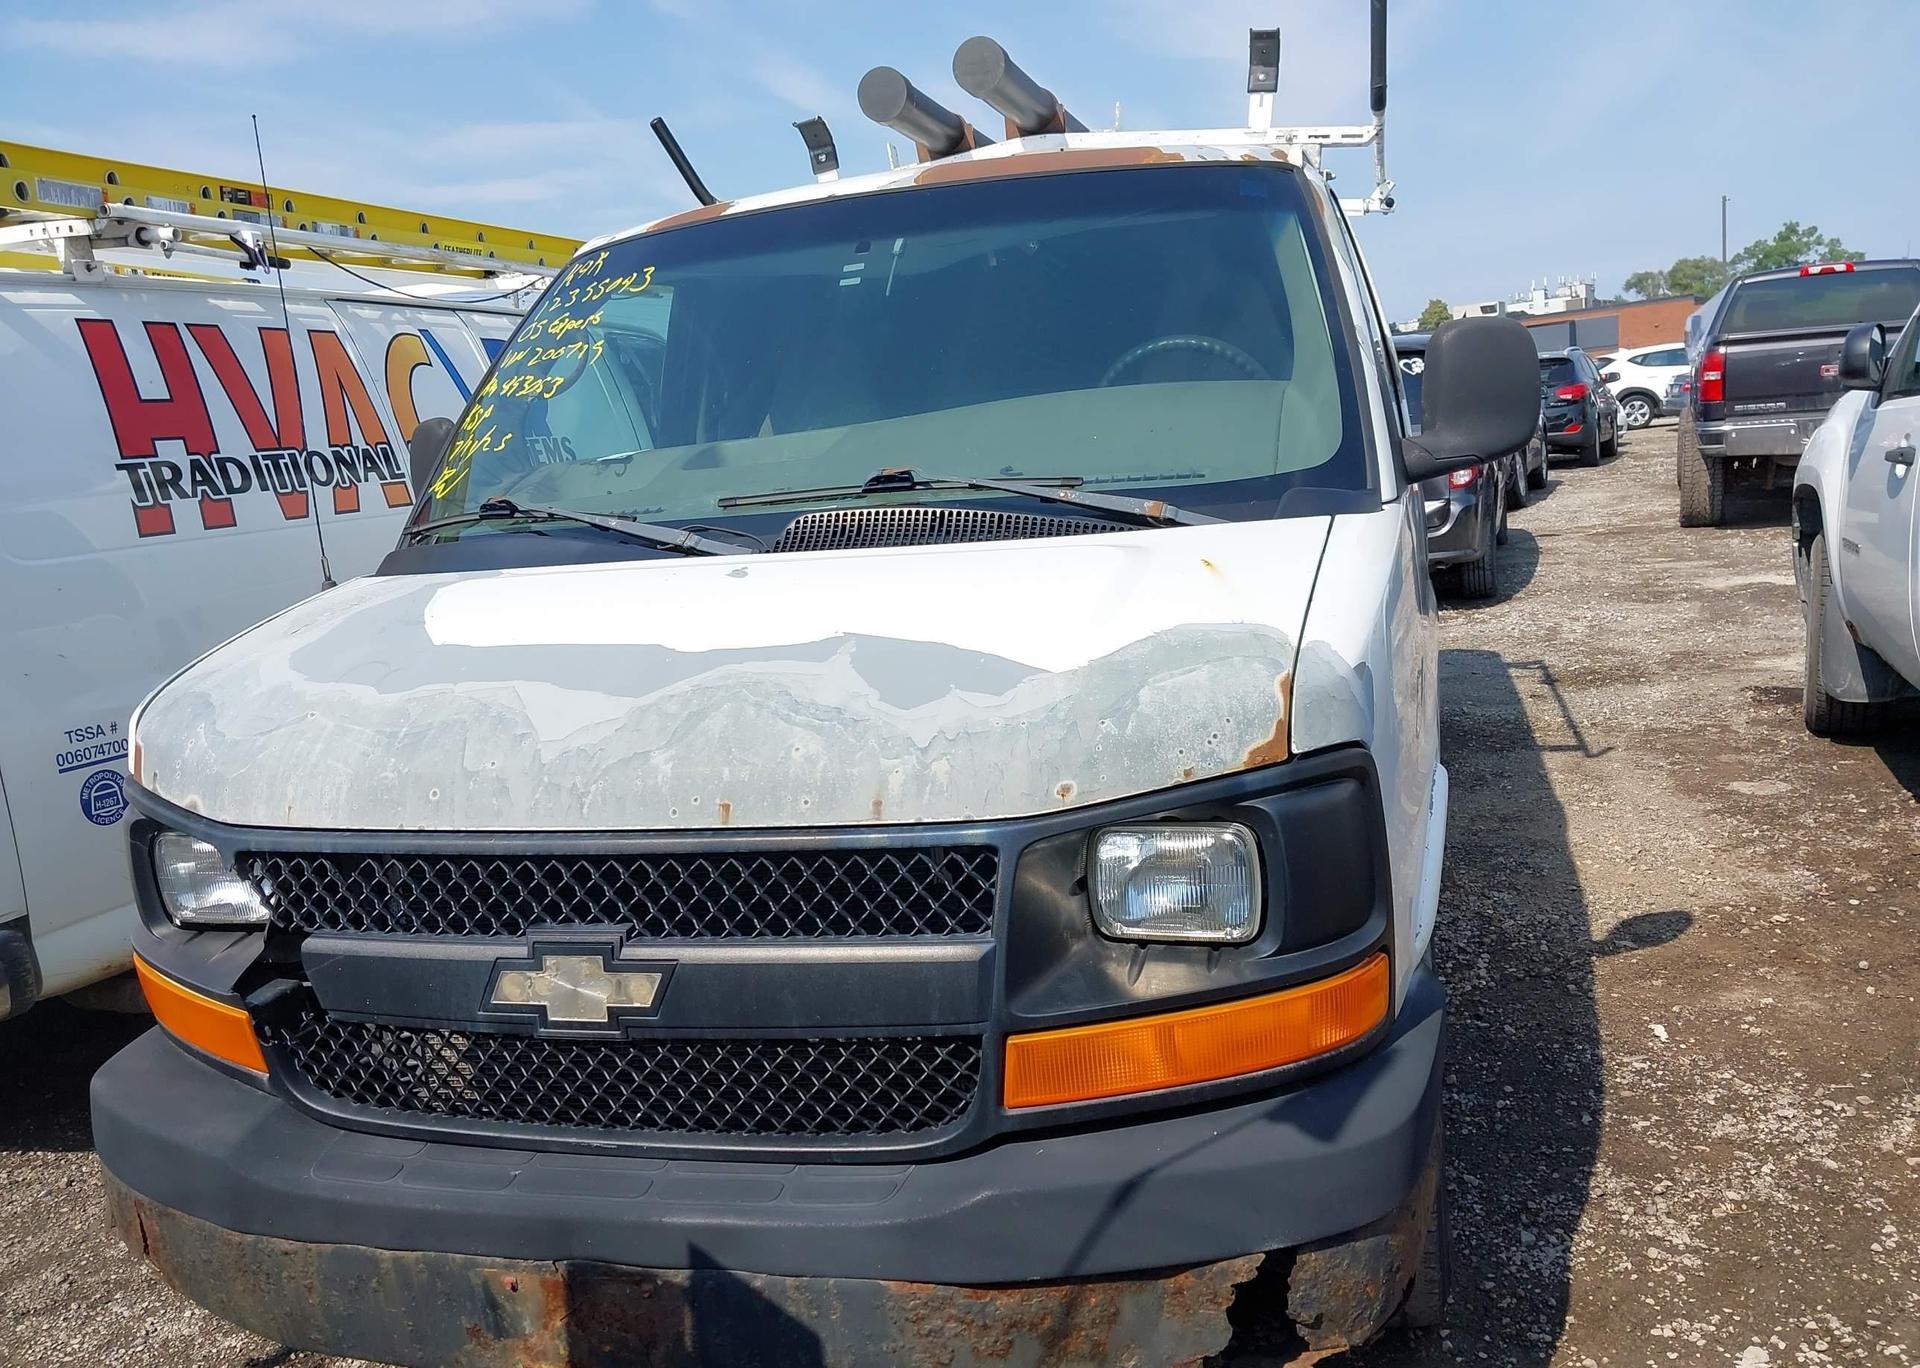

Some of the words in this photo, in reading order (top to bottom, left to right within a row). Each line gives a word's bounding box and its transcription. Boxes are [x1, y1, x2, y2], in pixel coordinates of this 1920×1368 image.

[75, 318, 433, 539] HVAC
[114, 442, 406, 506] TRADITIONAL
[64, 724, 106, 744] TSSA
[109, 721, 118, 735] #
[56, 738, 129, 767] 006074700
[82, 771, 124, 800] METROPOLITA
